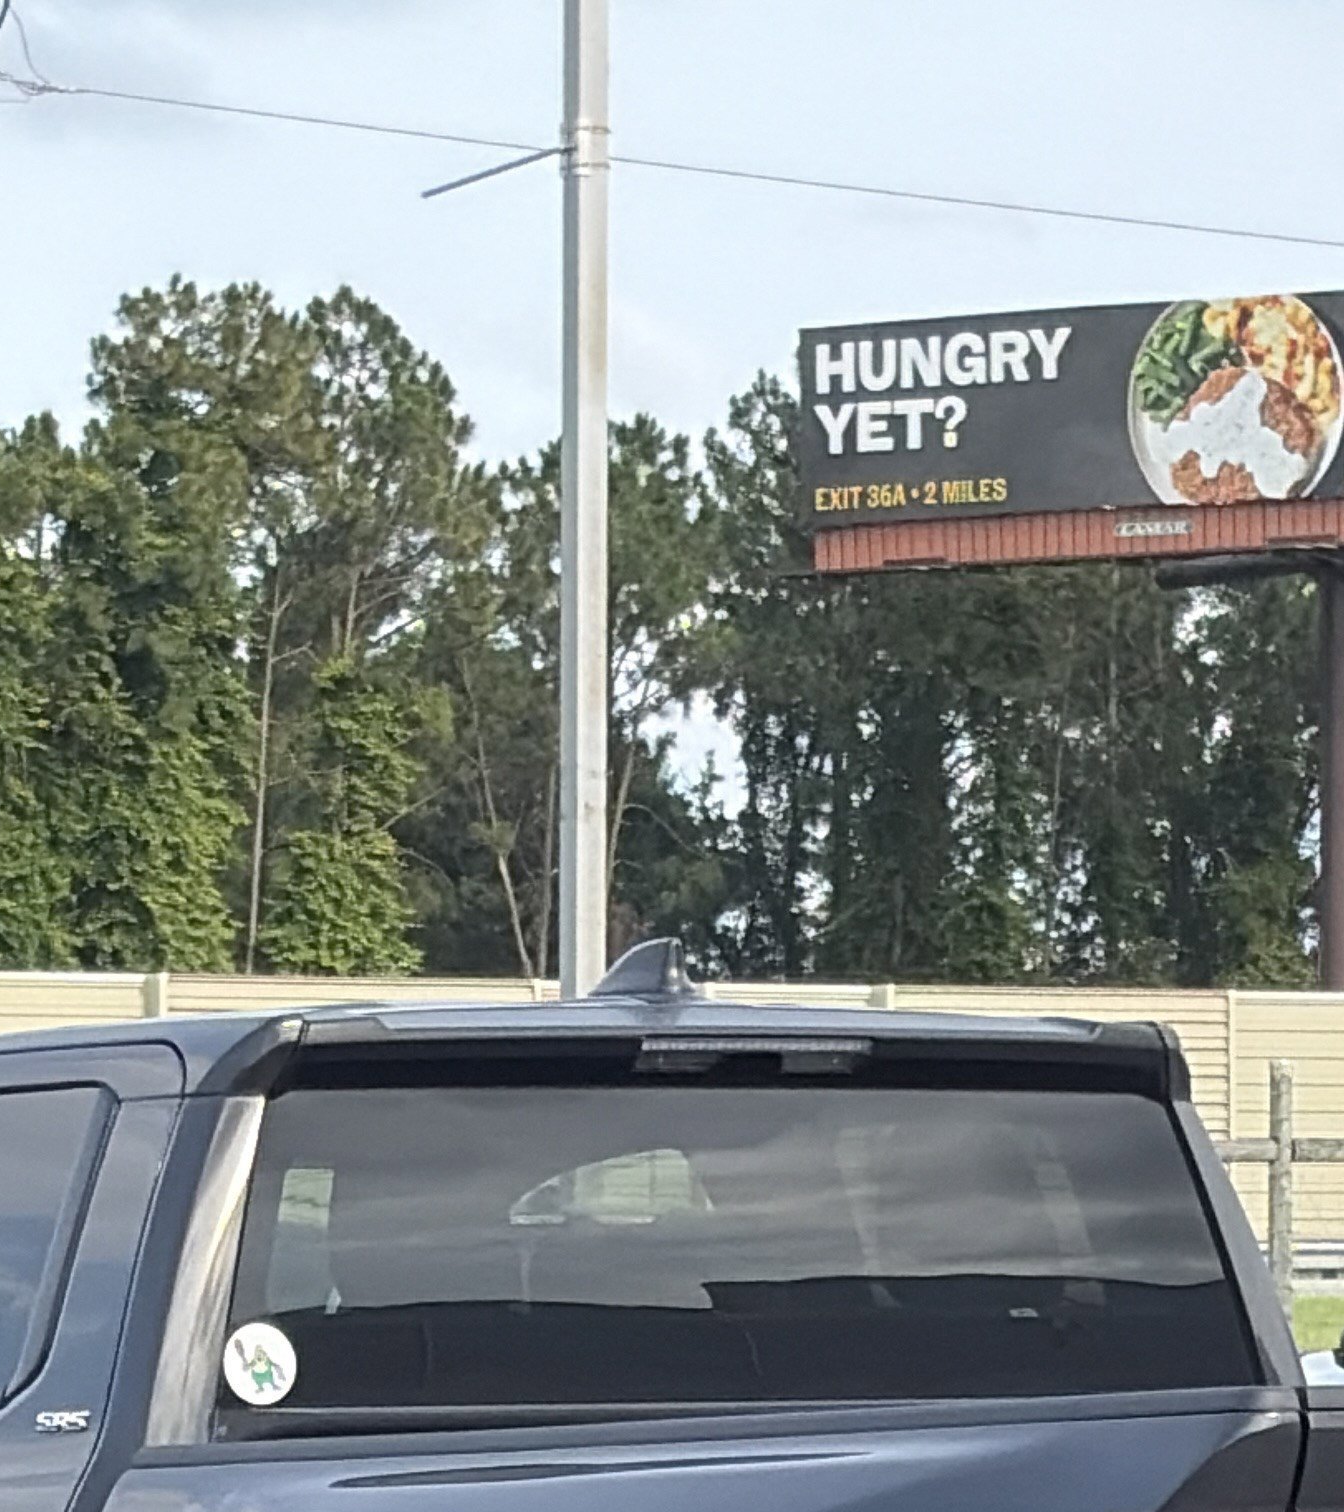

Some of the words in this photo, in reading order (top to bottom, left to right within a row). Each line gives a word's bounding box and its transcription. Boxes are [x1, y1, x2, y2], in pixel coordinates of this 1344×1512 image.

[815, 326, 1072, 394] HUNGRY
[813, 395, 968, 455] YET?
[814, 485, 863, 511] EXIT
[866, 482, 906, 508] 36A
[922, 481, 938, 504] 2
[942, 478, 1008, 504] MILES
